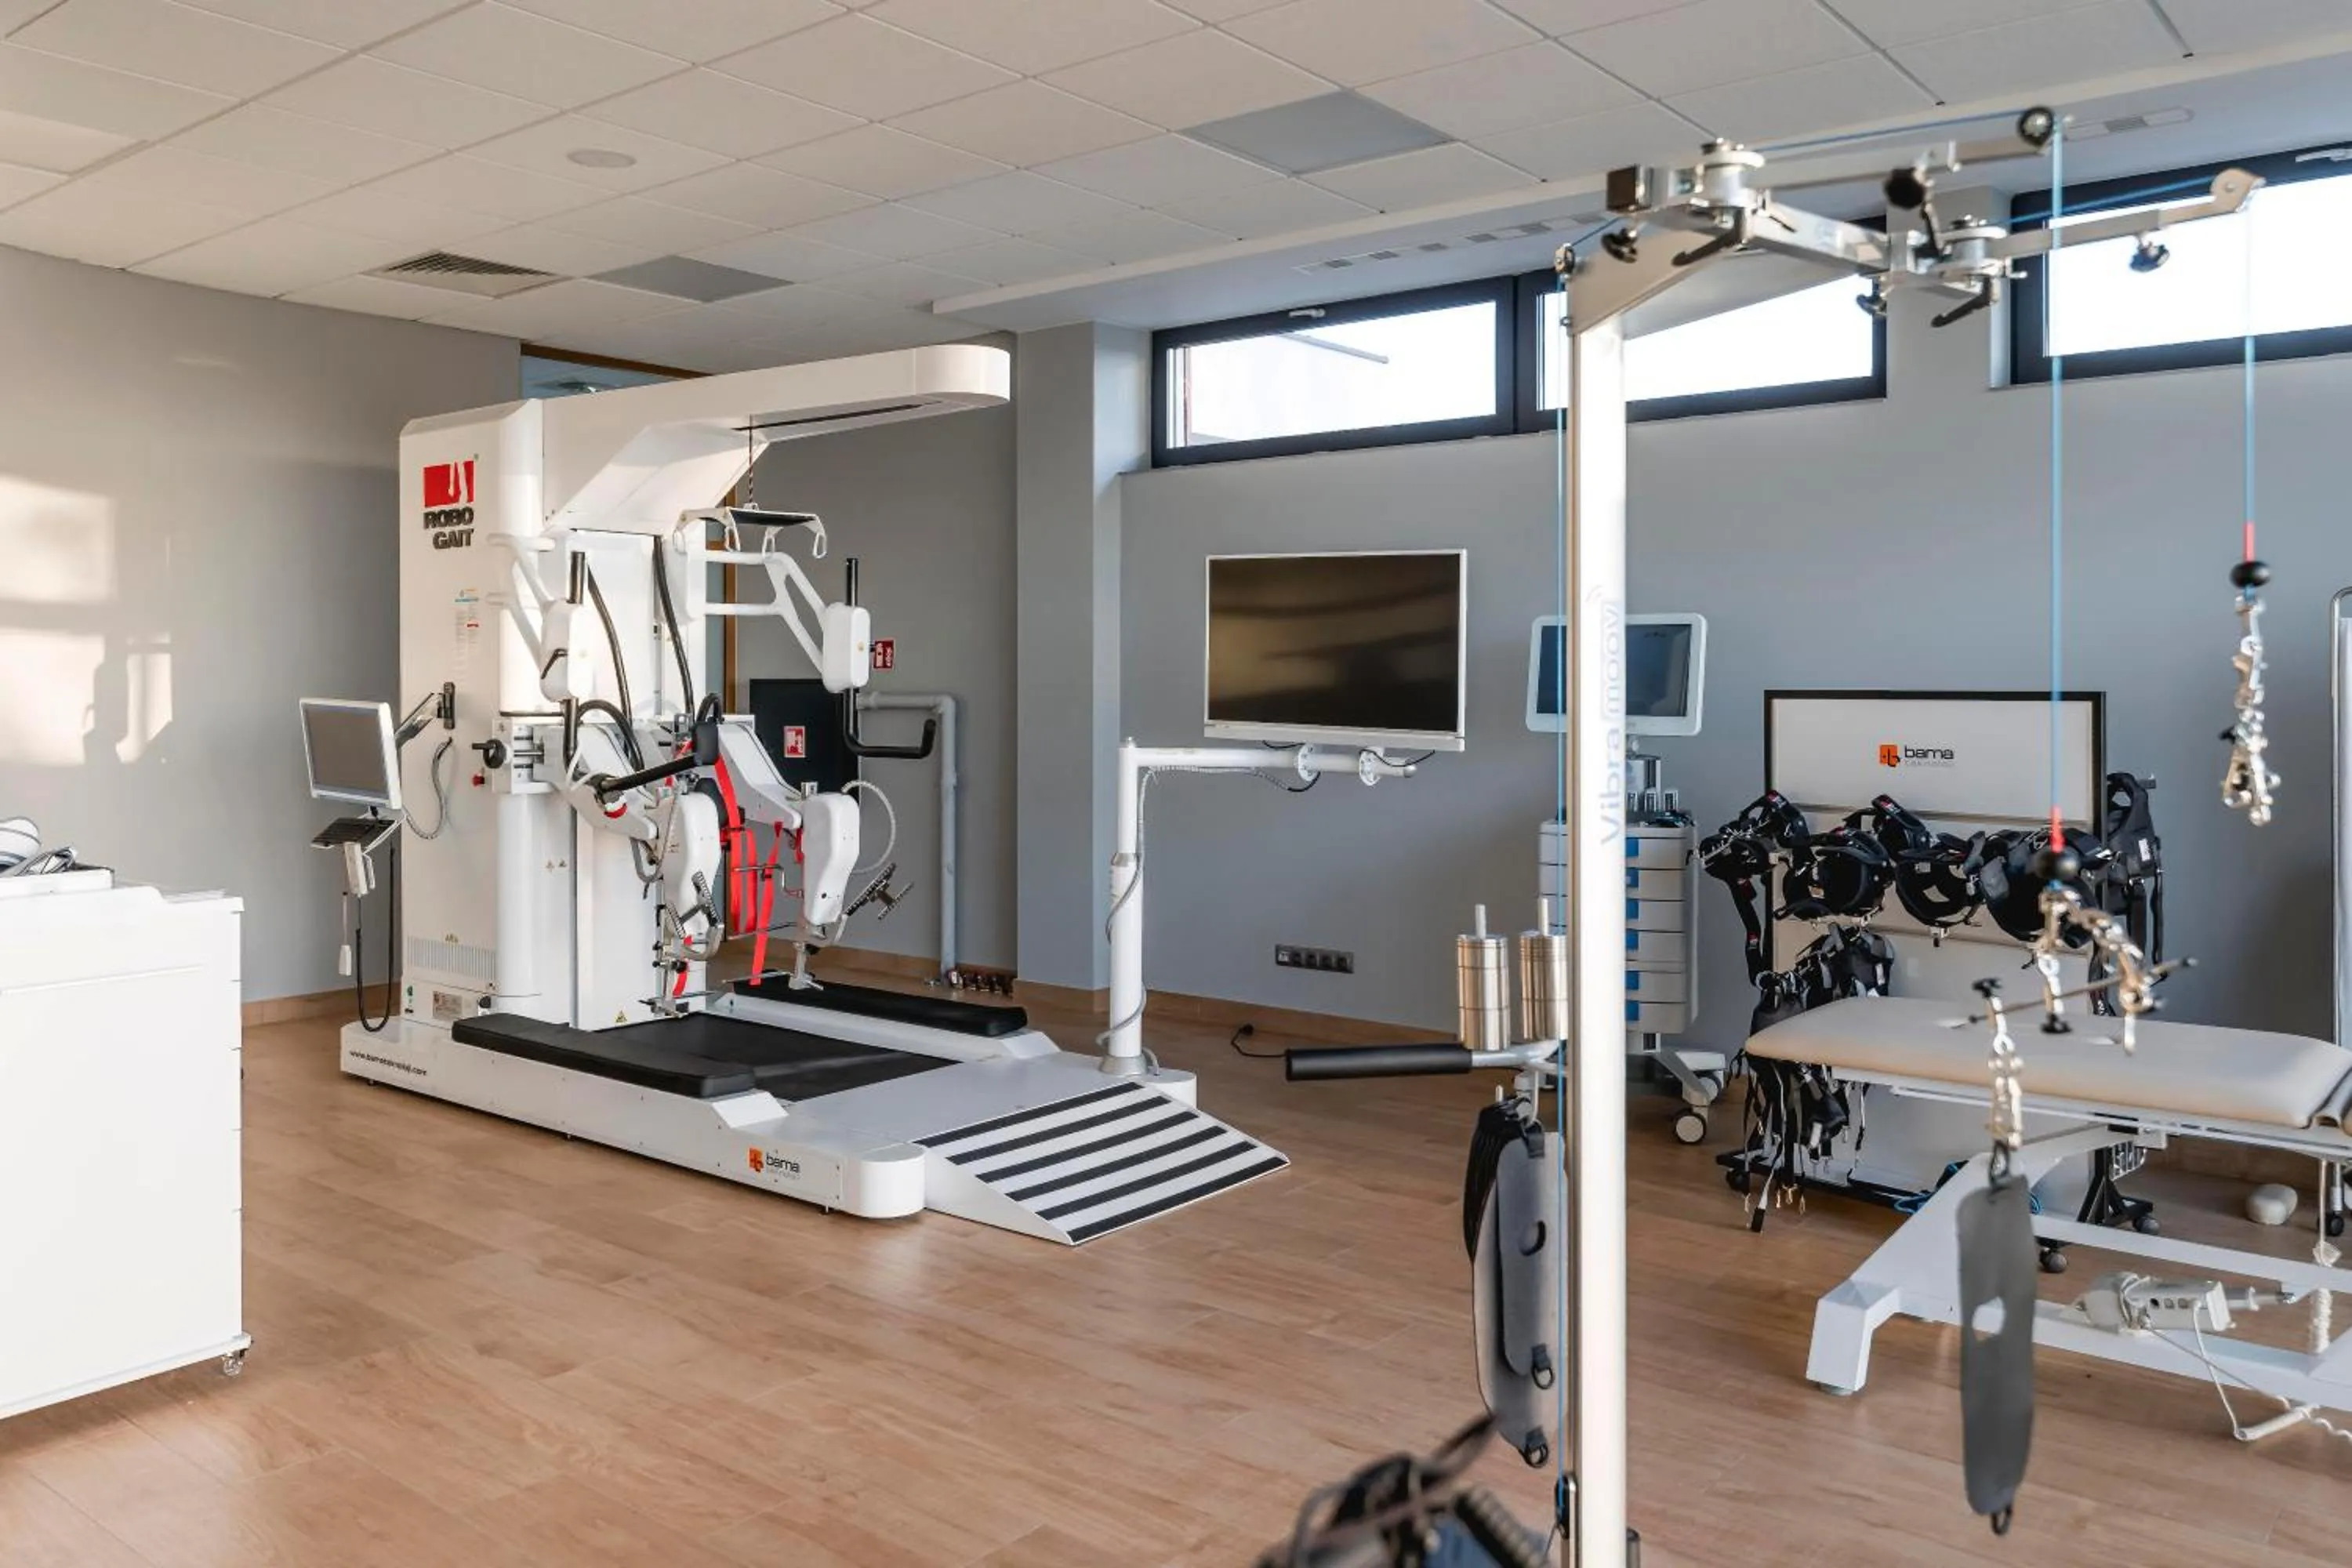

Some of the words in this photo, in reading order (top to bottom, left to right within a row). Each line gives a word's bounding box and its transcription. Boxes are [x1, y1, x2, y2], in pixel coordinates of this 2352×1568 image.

[423, 507, 474, 529] ROBO
[433, 529, 474, 550] GAIT
[1604, 605, 1621, 715] moov
[1904, 745, 1954, 759] bama
[1599, 728, 1621, 845] Vibra
[766, 1152, 800, 1173] bama
